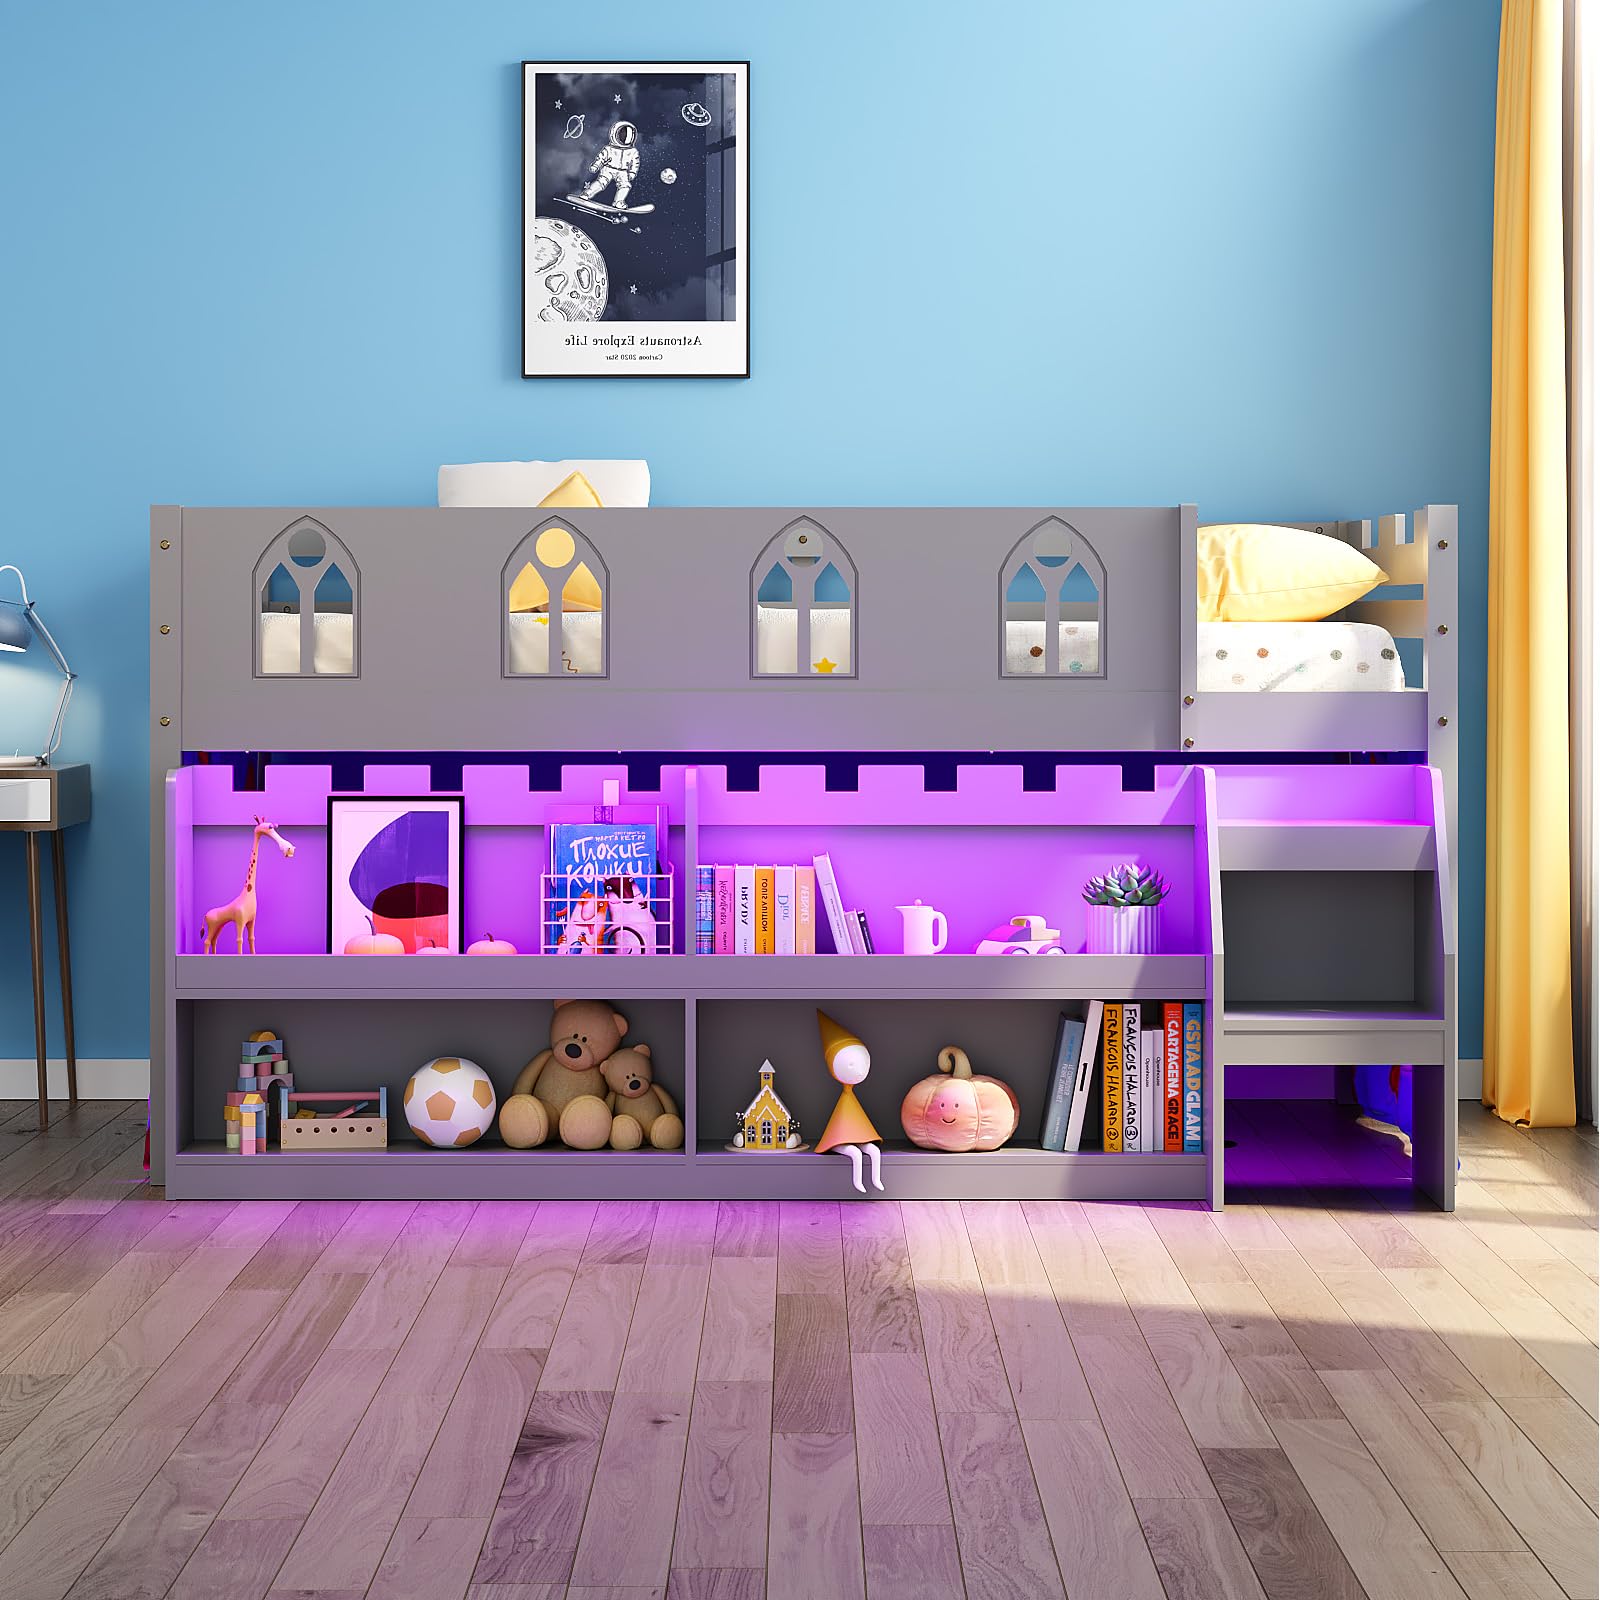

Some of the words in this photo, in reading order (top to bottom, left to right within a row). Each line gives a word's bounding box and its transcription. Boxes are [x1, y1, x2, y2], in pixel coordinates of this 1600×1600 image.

[1167, 1020, 1179, 1098] CARTAGENA
[1186, 1019, 1201, 1091] GSTAAD
[1107, 1075, 1120, 1126] HALARD
[1125, 1073, 1138, 1125] HALARD
[1167, 1098, 1179, 1139] GRACE
[1186, 1091, 1201, 1141] GLAM
